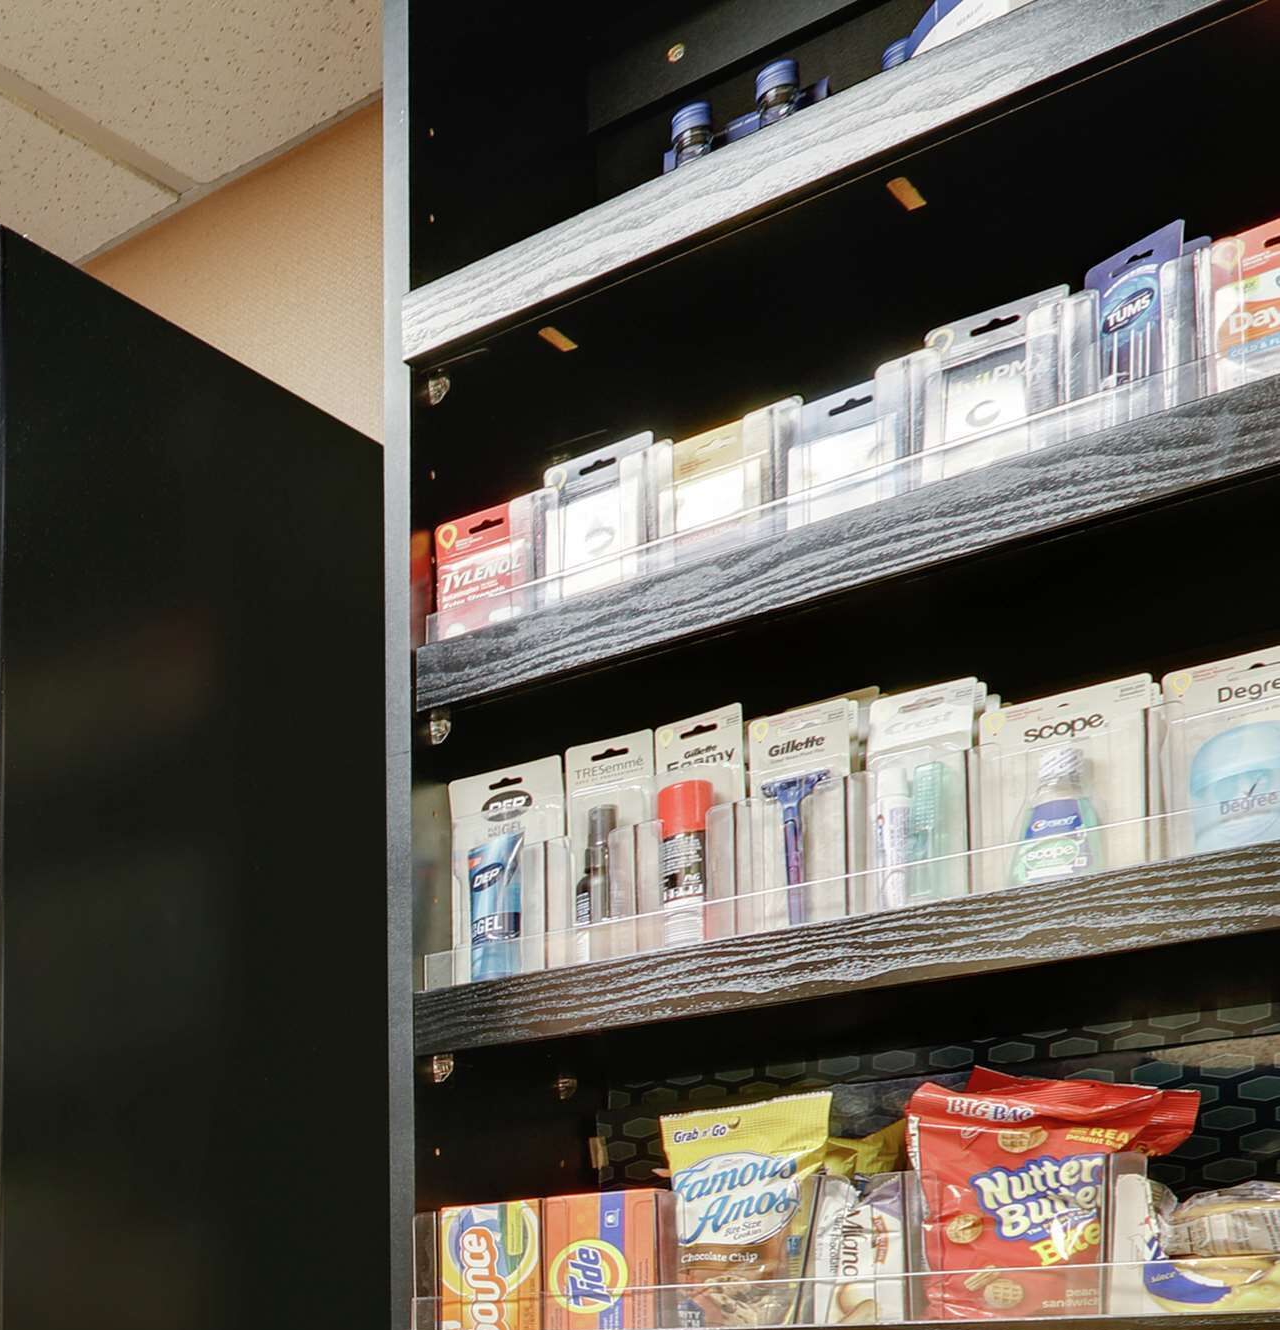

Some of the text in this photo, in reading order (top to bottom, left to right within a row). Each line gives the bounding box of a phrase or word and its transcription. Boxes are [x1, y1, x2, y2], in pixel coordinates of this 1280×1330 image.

[1106, 293, 1152, 327] TUMS
[1228, 306, 1280, 335] Day
[441, 556, 523, 594] TYLENOL
[1024, 711, 1105, 744] scope
[684, 743, 718, 759] Gillette
[768, 734, 826, 758] Gillette
[575, 757, 644, 780] TRESemmé
[946, 1096, 989, 1118] BIG
[673, 1130, 700, 1143] Grab
[712, 1124, 728, 1137] Go
[1091, 1126, 1131, 1143] REA
[673, 1157, 798, 1203] Famous
[974, 1156, 1105, 1211] Nutter
[679, 1187, 801, 1244] Amos
[729, 1251, 759, 1263] Chip
[569, 1247, 613, 1307] Tide
[1042, 1297, 1099, 1309] sandwic
